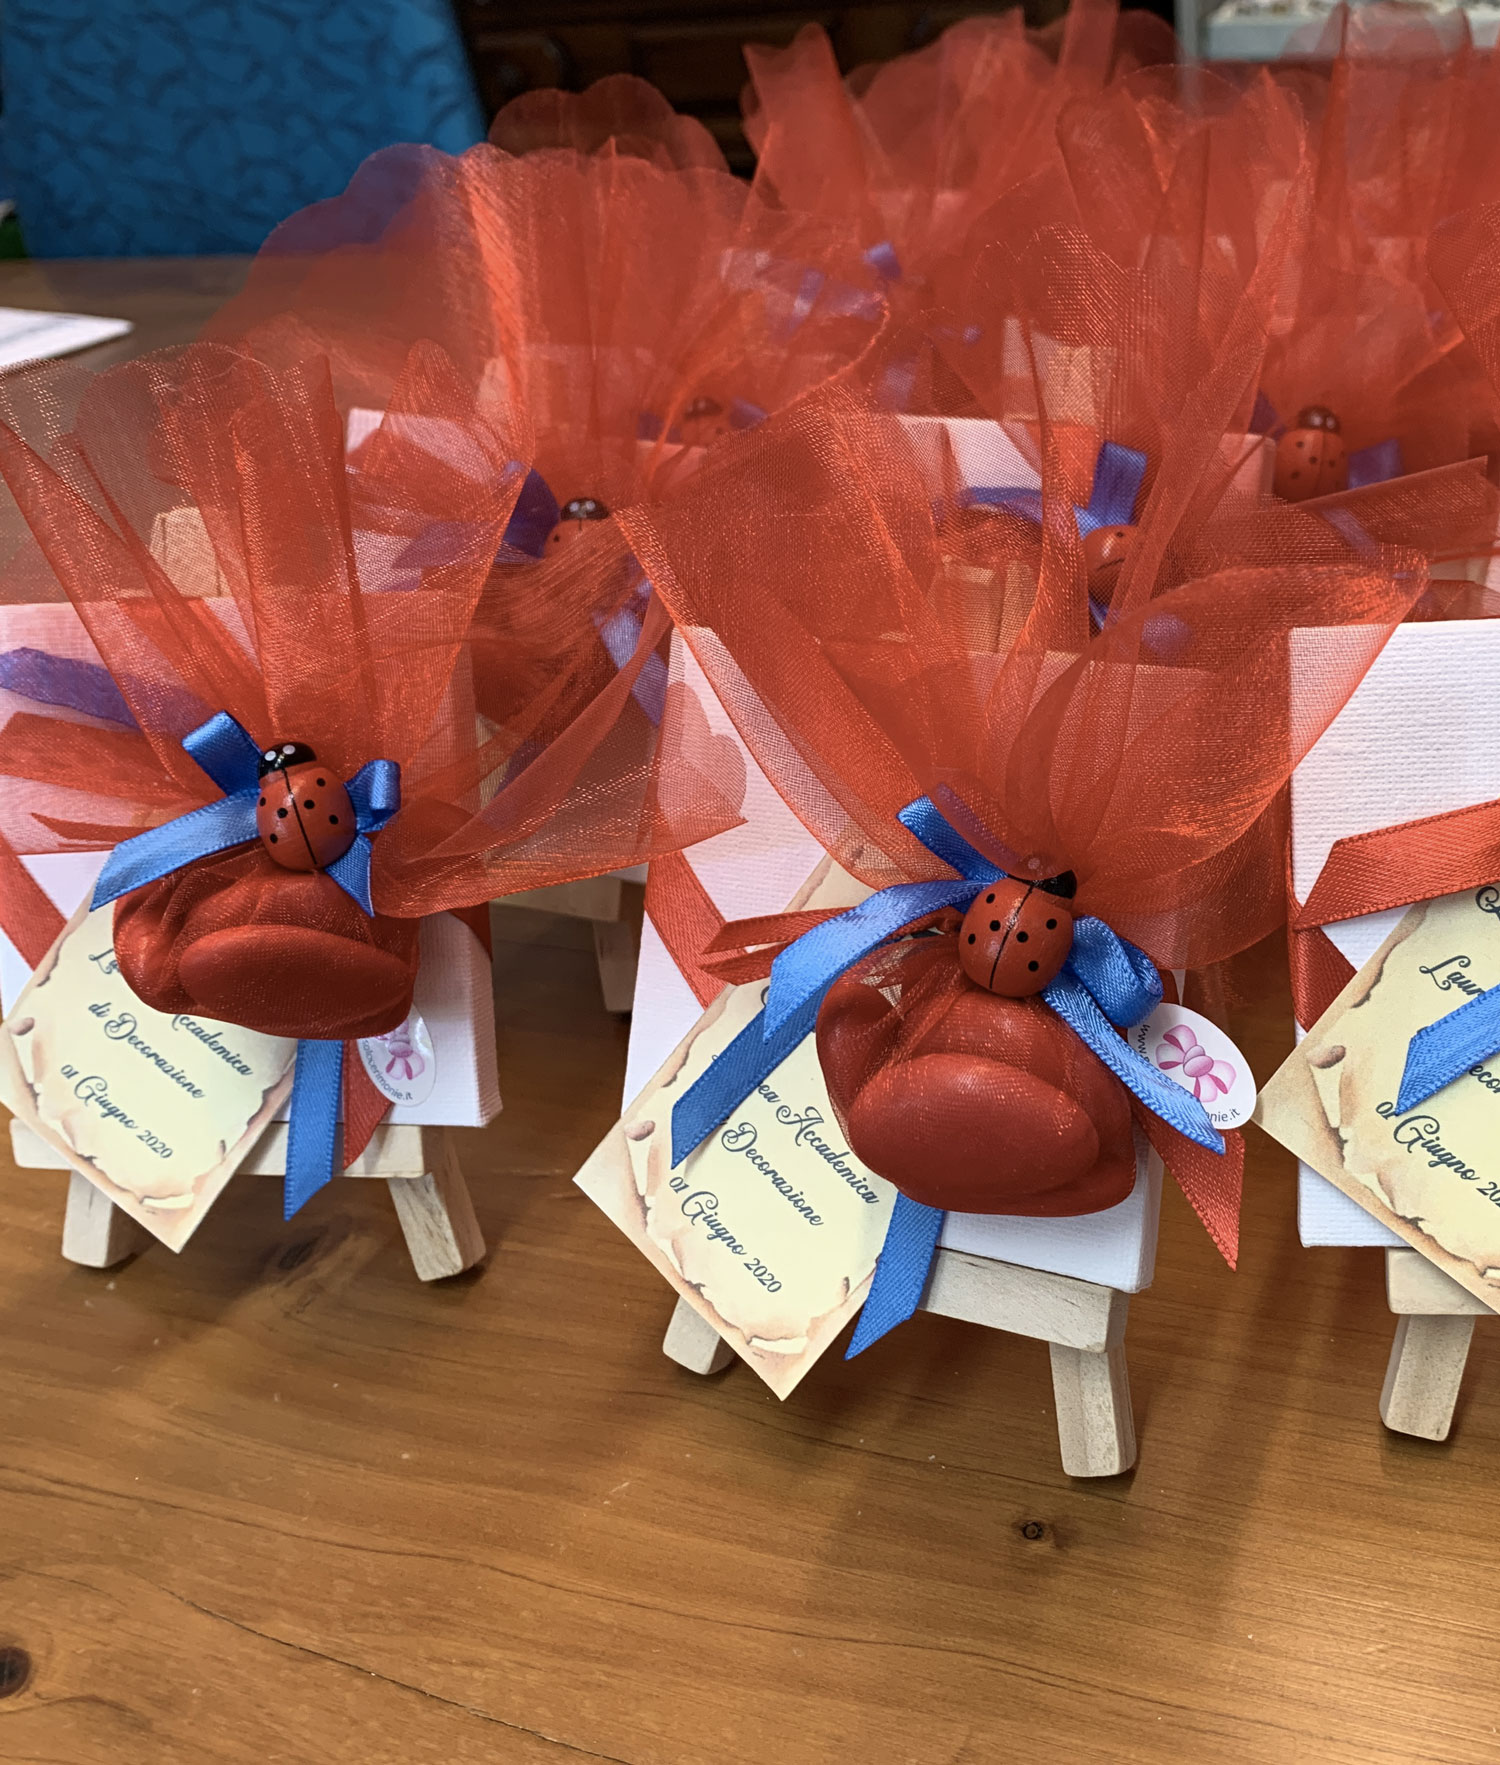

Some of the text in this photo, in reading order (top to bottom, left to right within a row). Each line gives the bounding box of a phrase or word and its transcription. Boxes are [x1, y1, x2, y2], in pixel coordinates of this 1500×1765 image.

[88, 1002, 205, 1098] di Decorazione
[60, 1064, 173, 1158] 01 Giugno 2020
[776, 1105, 879, 1204] Accademica
[1393, 1115, 1480, 1180] Giugno
[721, 1122, 824, 1226] Decorazione
[669, 1176, 782, 1292] 01 Giugno 2020
